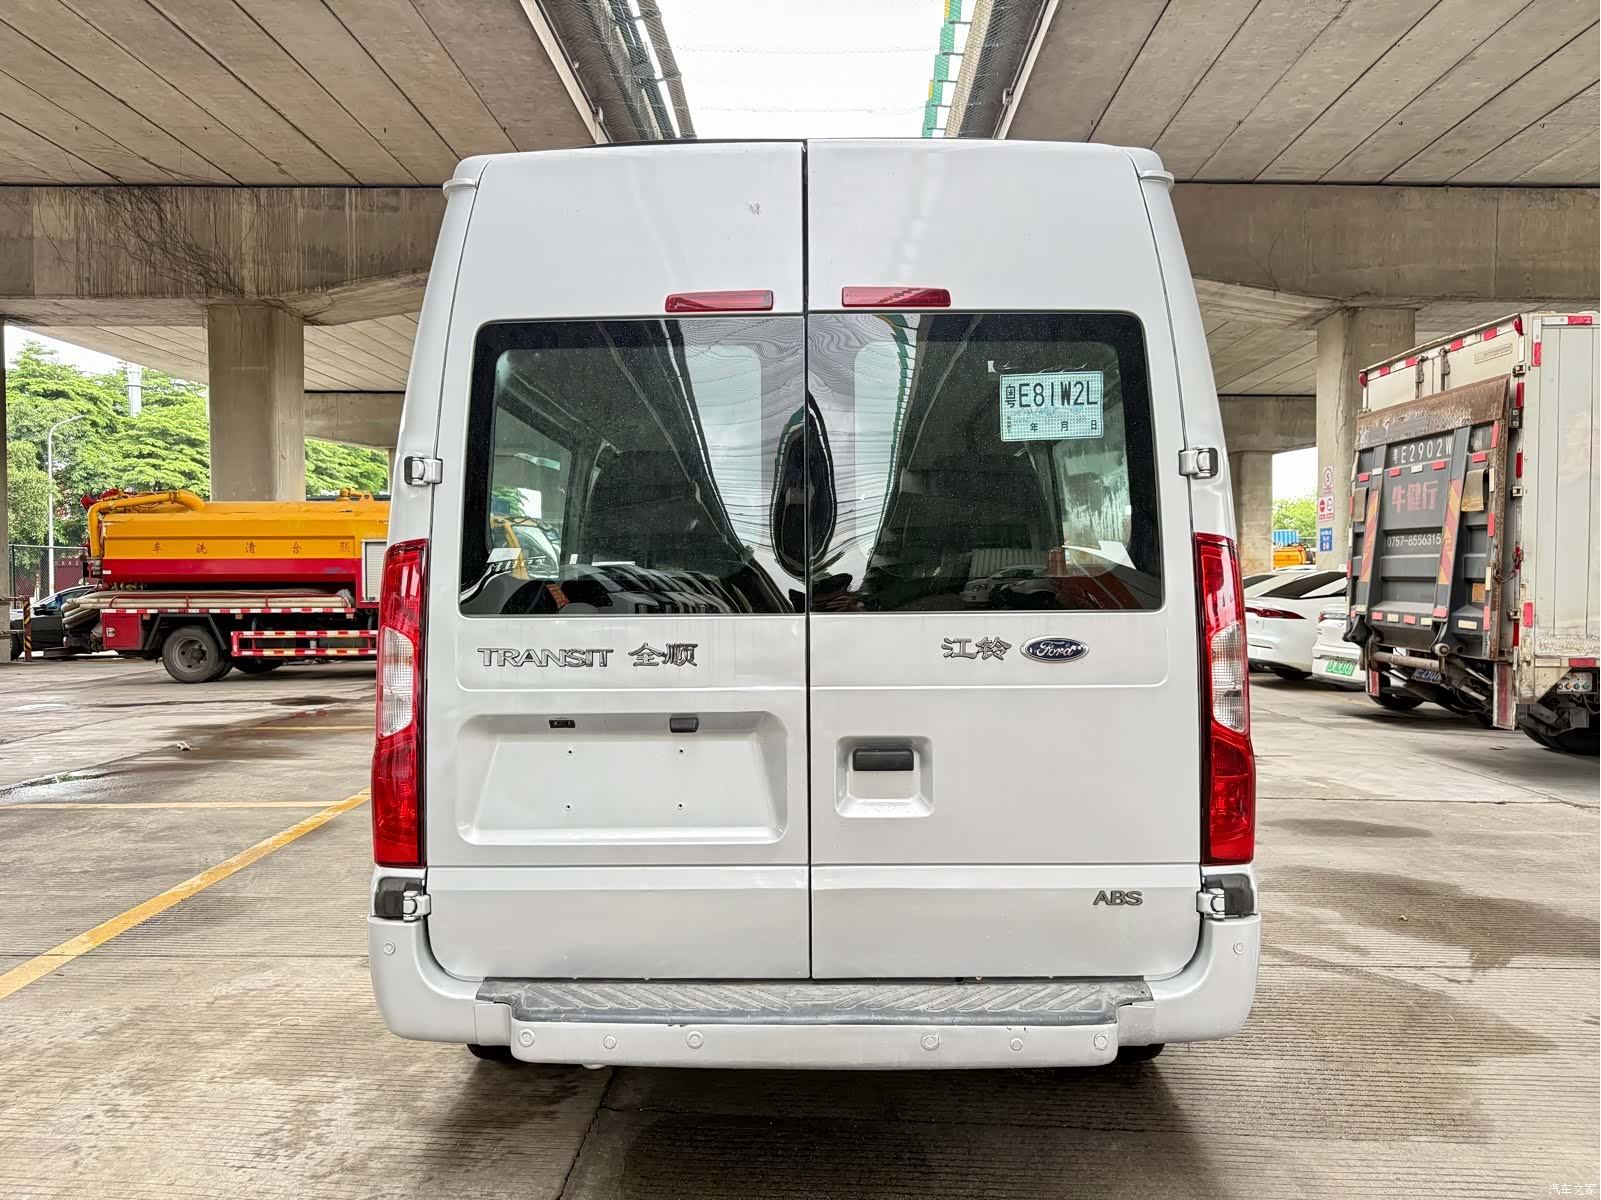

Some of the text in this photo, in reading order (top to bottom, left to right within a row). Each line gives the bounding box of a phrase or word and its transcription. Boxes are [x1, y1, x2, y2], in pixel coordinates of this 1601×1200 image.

[477, 647, 614, 667] TRANSIT
[628, 642, 699, 667] 全顺
[941, 636, 1012, 661] 江铃
[1036, 641, 1074, 657] Ford
[1093, 890, 1143, 906] ABS
